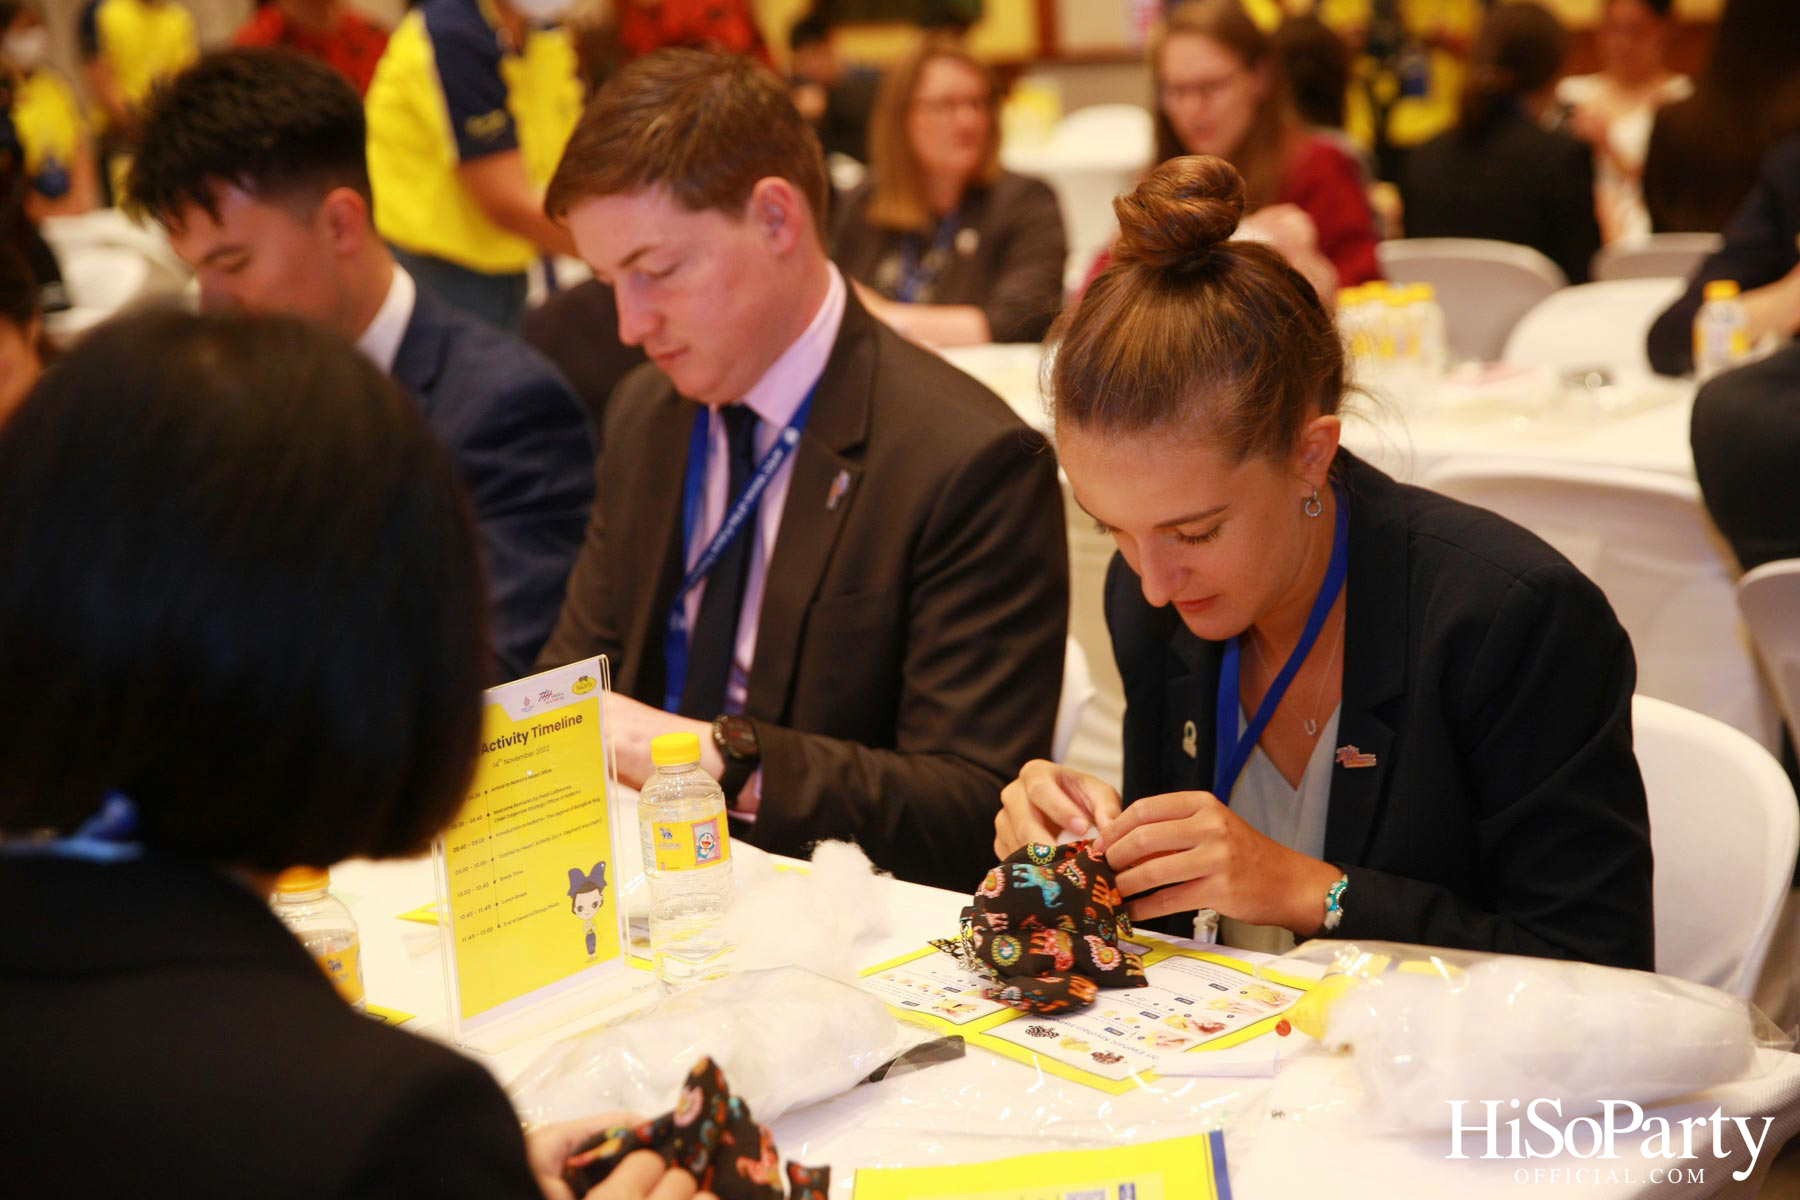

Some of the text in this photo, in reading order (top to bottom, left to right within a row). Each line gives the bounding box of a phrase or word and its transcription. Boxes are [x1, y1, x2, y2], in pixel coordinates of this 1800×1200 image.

[481, 714, 583, 755] Activity Timeline
[504, 752, 534, 765] November
[536, 745, 550, 755] 2022
[475, 882, 489, 891] 10.45
[478, 904, 491, 914] 11.45
